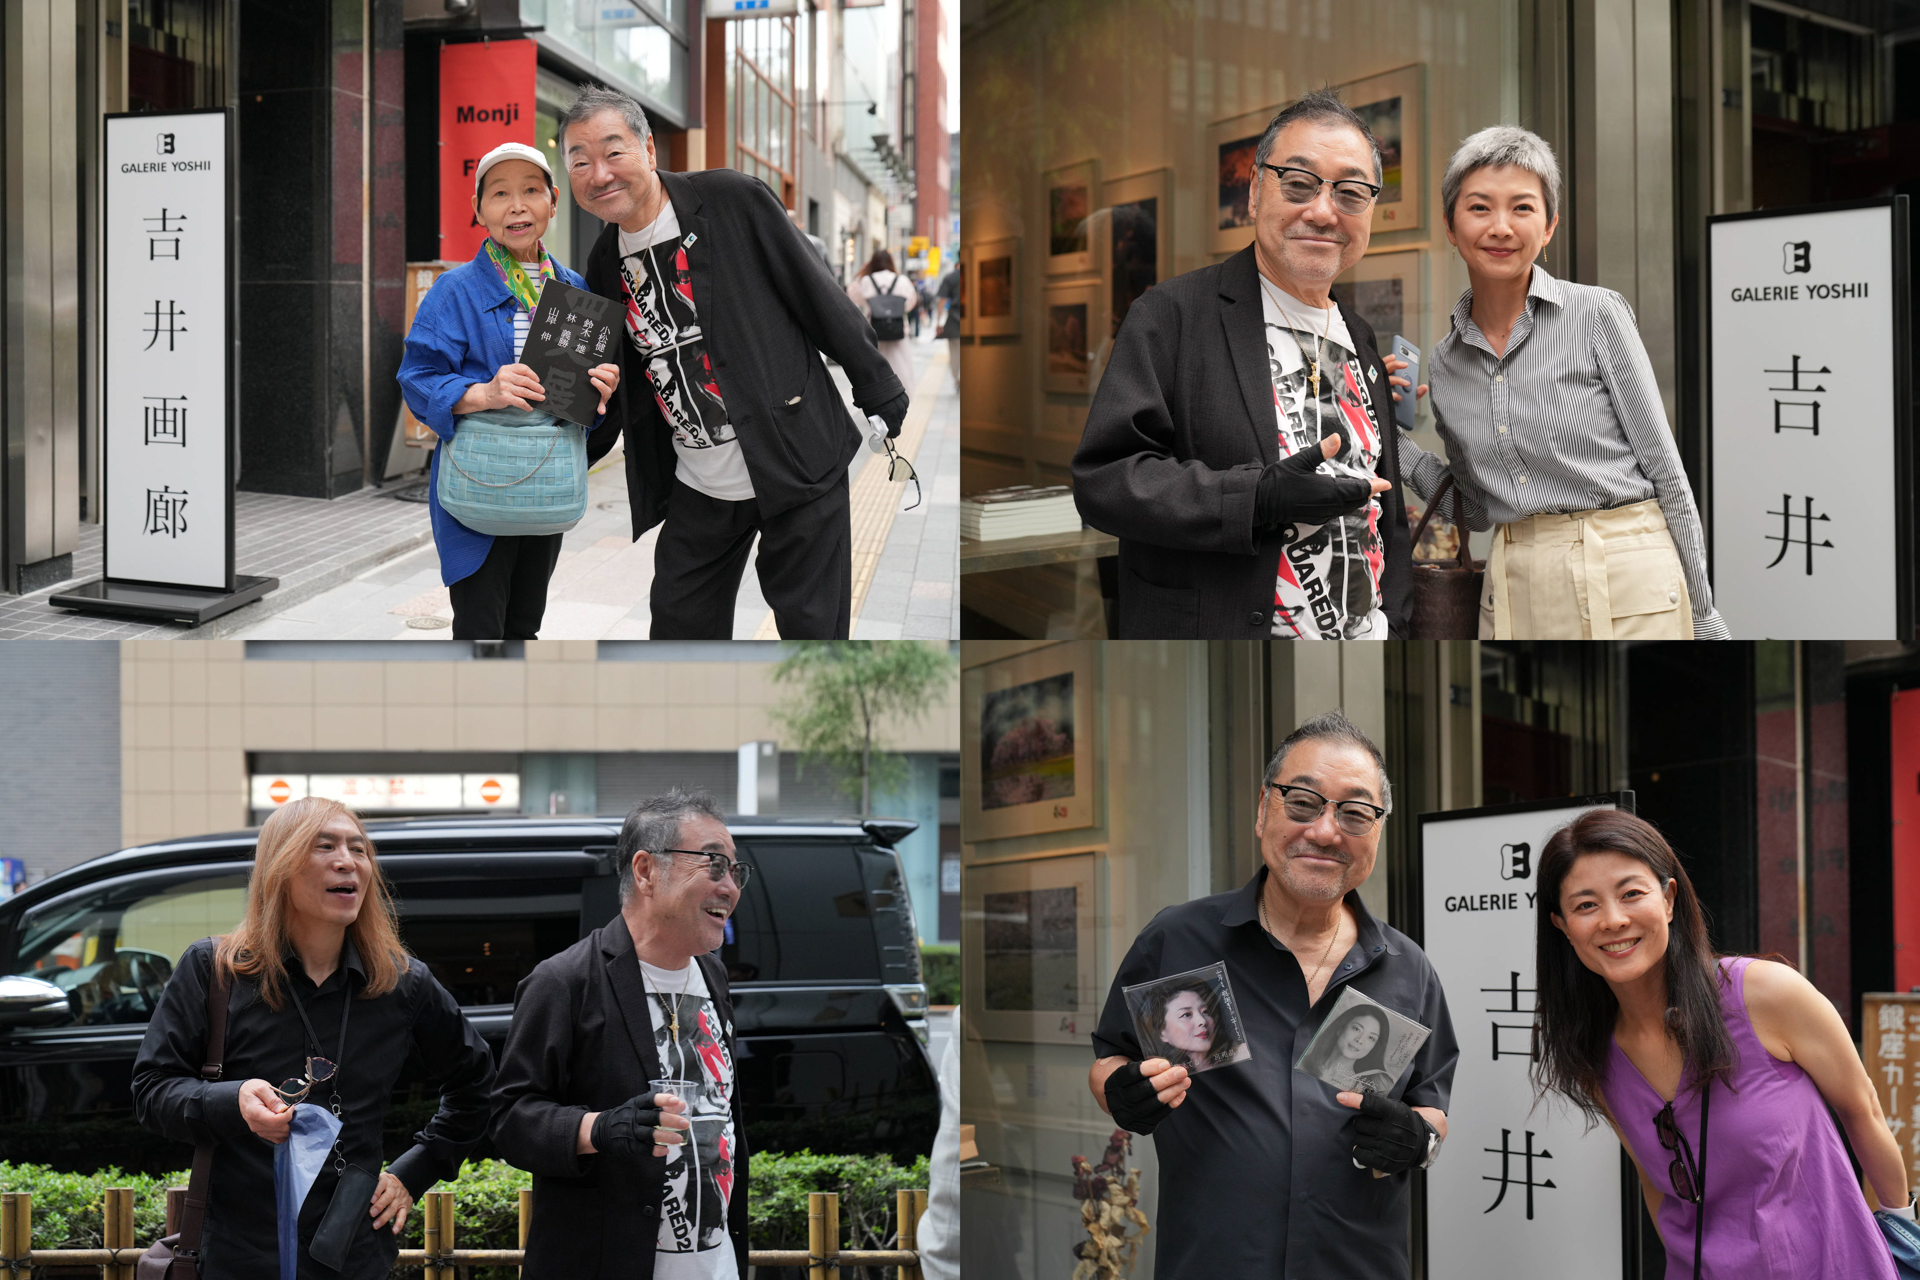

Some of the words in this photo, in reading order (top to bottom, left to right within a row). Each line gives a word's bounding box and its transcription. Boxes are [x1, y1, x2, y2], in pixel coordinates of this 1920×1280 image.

[457, 103, 519, 125] Monji
[121, 162, 167, 173] GALERIE
[171, 160, 211, 172] YOSHII
[1731, 285, 1799, 302] GALERIE
[1806, 282, 1869, 300] YOSHII
[574, 318, 594, 355] 鈴木一雄
[592, 325, 611, 358] 小松健一
[143, 207, 188, 539] 吉井画廊
[1764, 354, 1835, 576] 吉井
[1445, 892, 1518, 912] GALERIE
